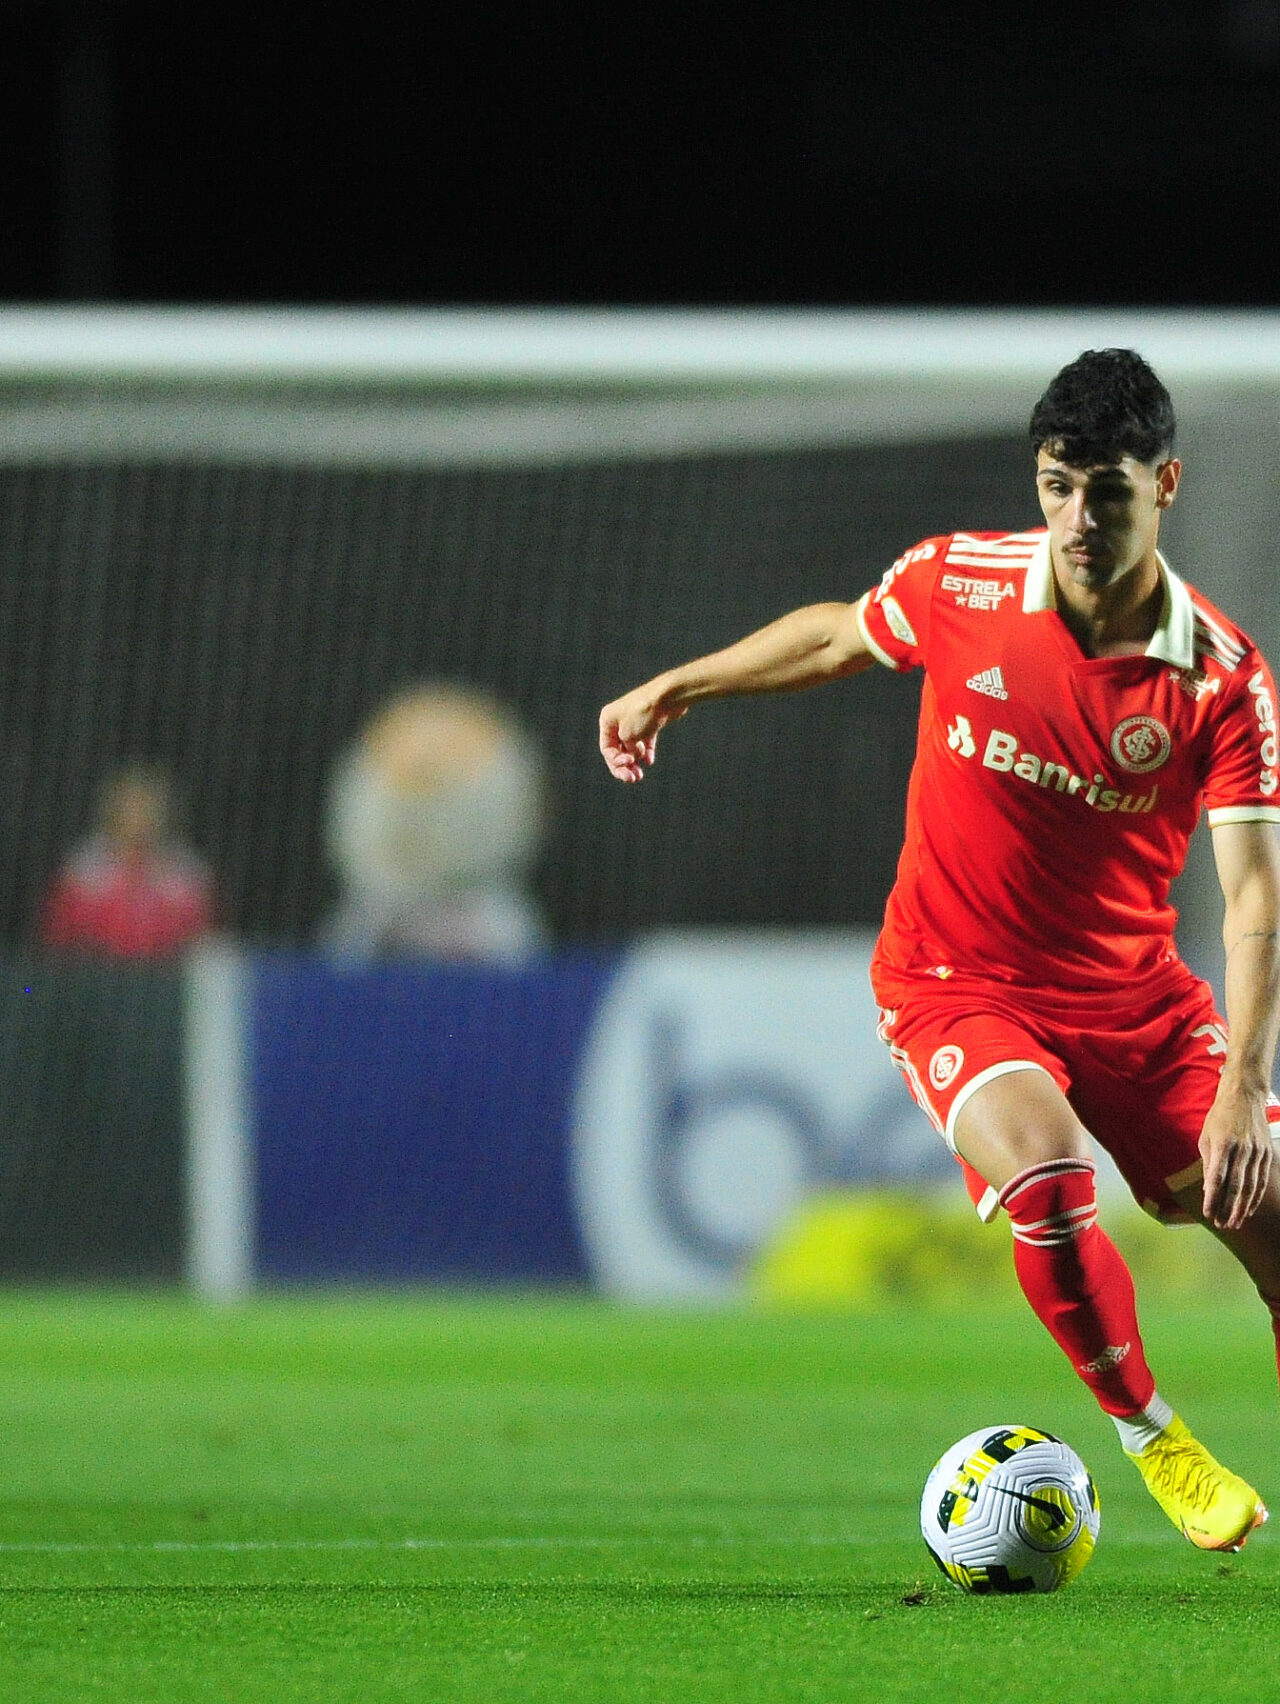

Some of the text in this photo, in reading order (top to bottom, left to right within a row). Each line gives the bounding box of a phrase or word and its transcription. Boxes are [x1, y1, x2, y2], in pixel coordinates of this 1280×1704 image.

[941, 575, 1015, 597] ESTRELA
[967, 594, 1002, 611] BET
[965, 679, 1009, 701] adidas
[1247, 670, 1278, 767] vero
[982, 728, 1160, 814] Banrisul
